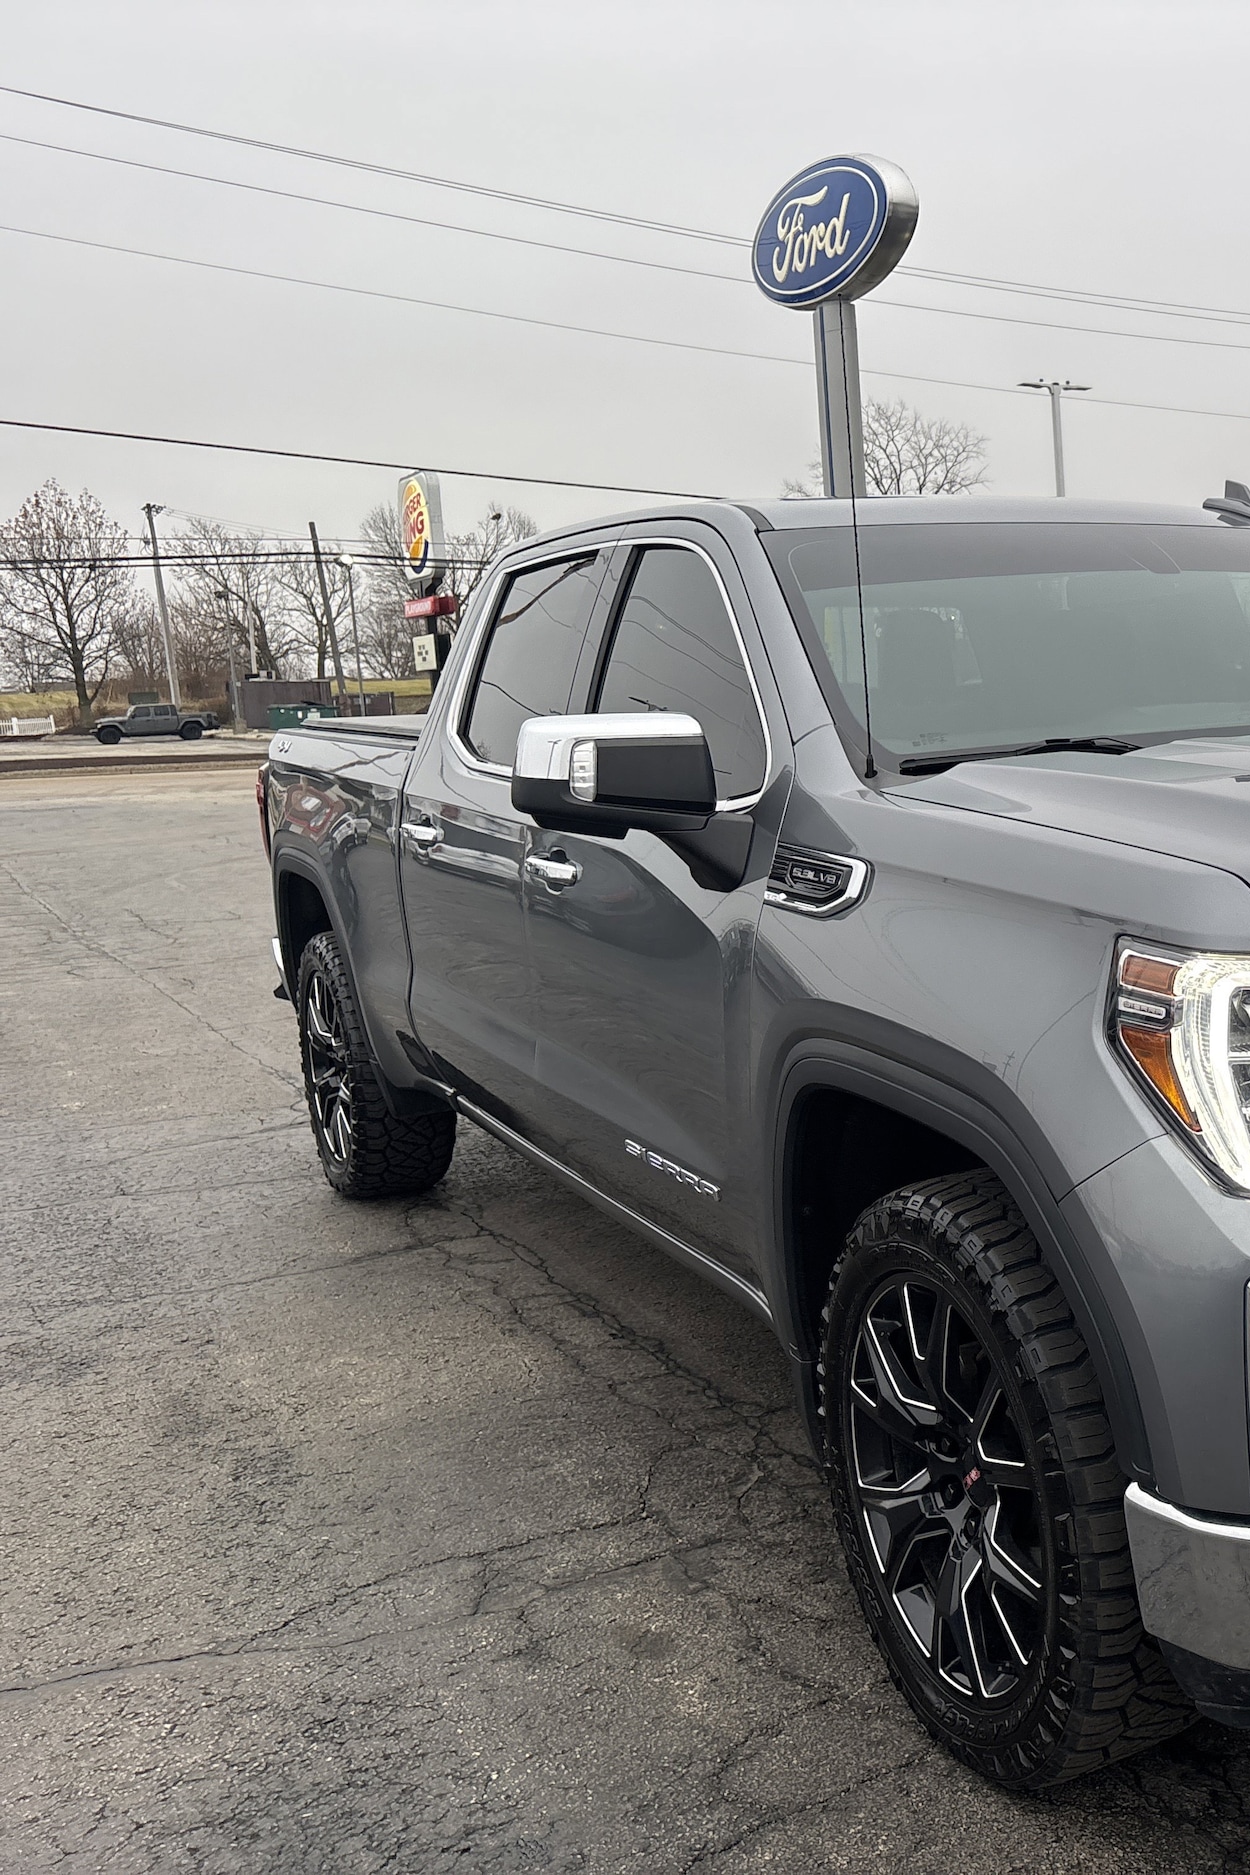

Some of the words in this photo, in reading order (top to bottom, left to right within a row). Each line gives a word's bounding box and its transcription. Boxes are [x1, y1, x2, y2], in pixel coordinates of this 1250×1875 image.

[773, 186, 850, 283] Ford
[1123, 1000, 1164, 1016] SIERRA
[625, 1139, 720, 1201] SIERRA
